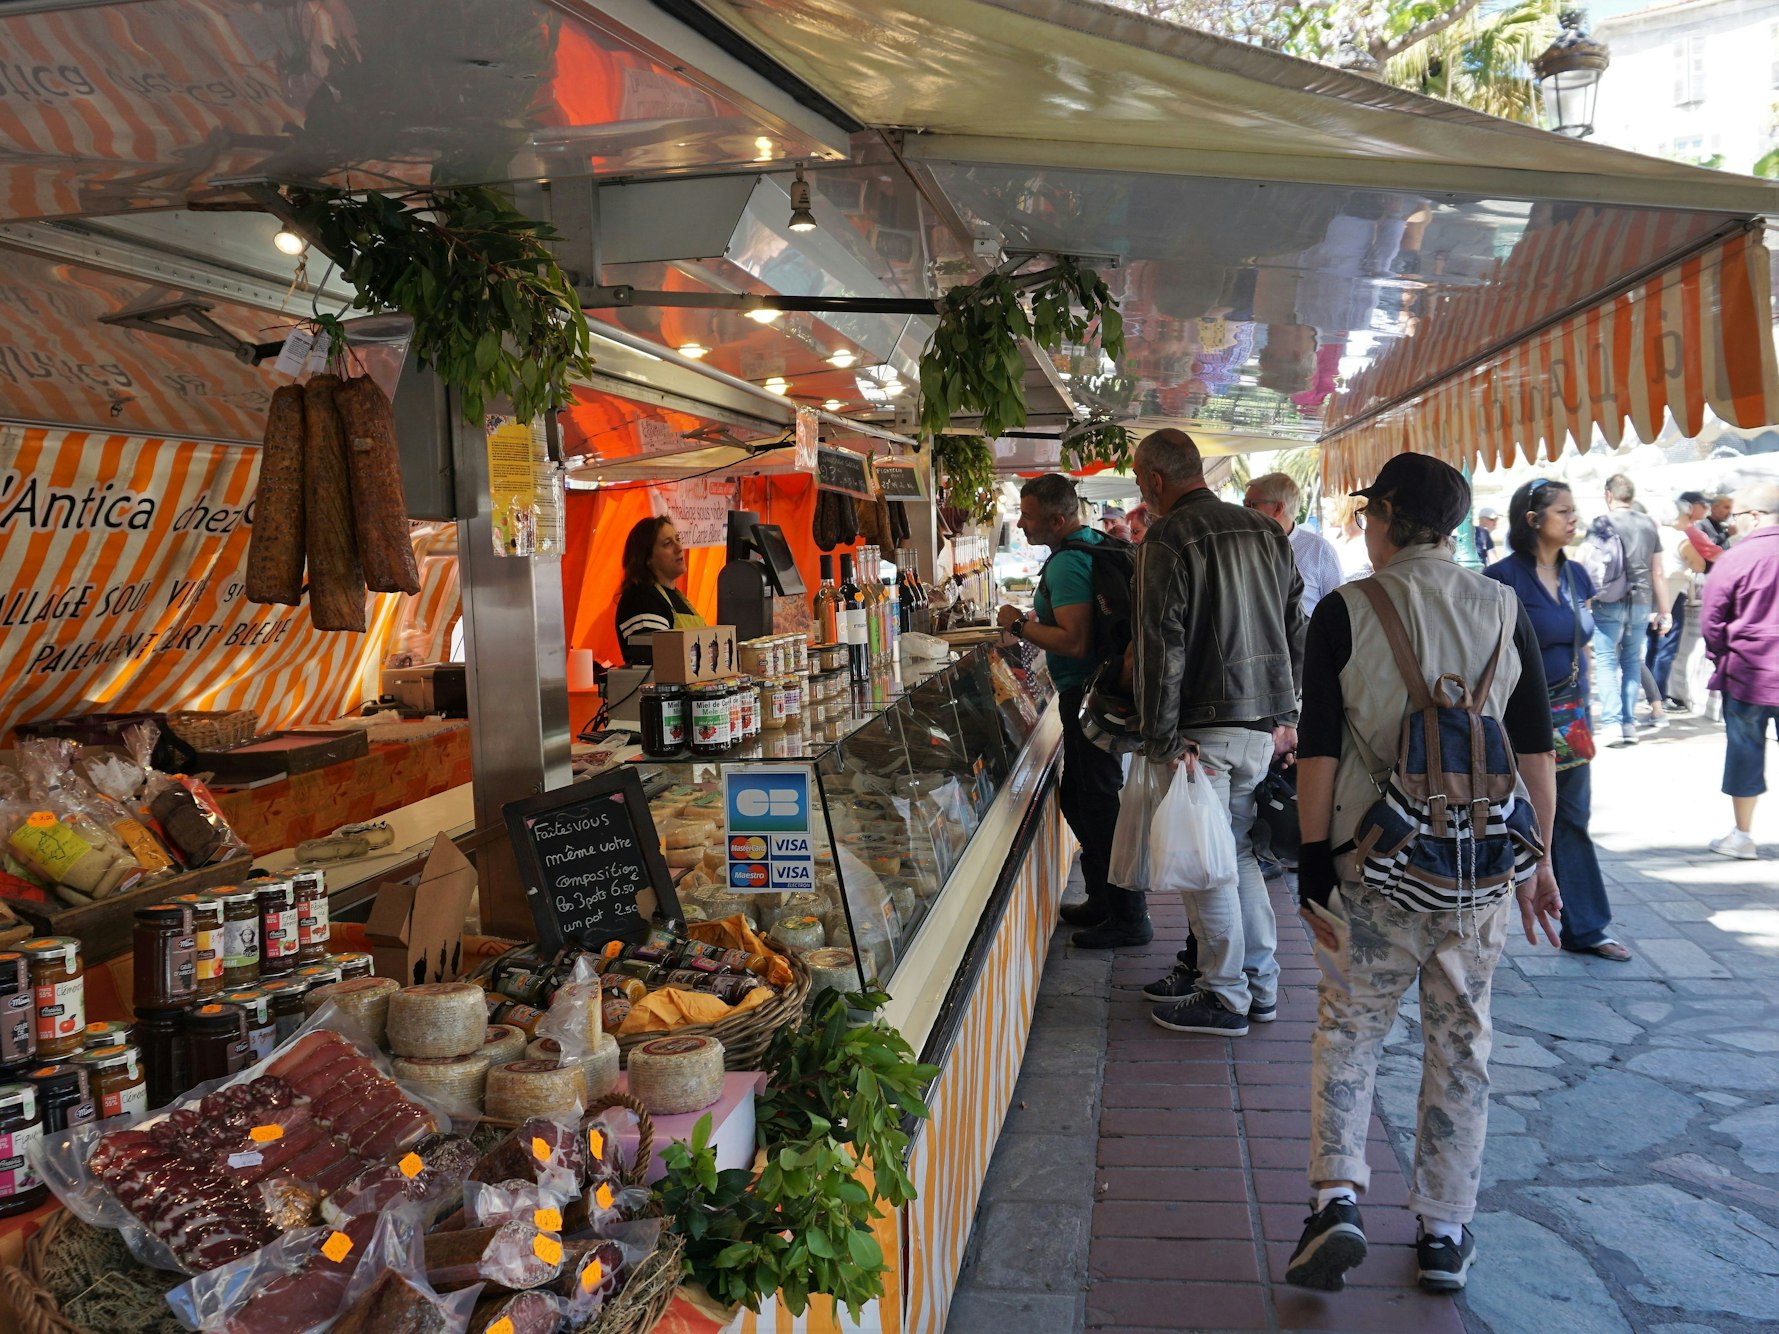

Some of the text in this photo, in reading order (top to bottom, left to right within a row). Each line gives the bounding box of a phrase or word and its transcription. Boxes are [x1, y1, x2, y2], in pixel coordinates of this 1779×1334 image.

[736, 789, 799, 816] CB
[545, 835, 632, 867] même votre
[730, 844, 766, 853] MasterCard
[775, 839, 808, 851] VISA
[734, 871, 765, 879] Maestro
[776, 866, 809, 879] VISA
[585, 908, 604, 928] pot
